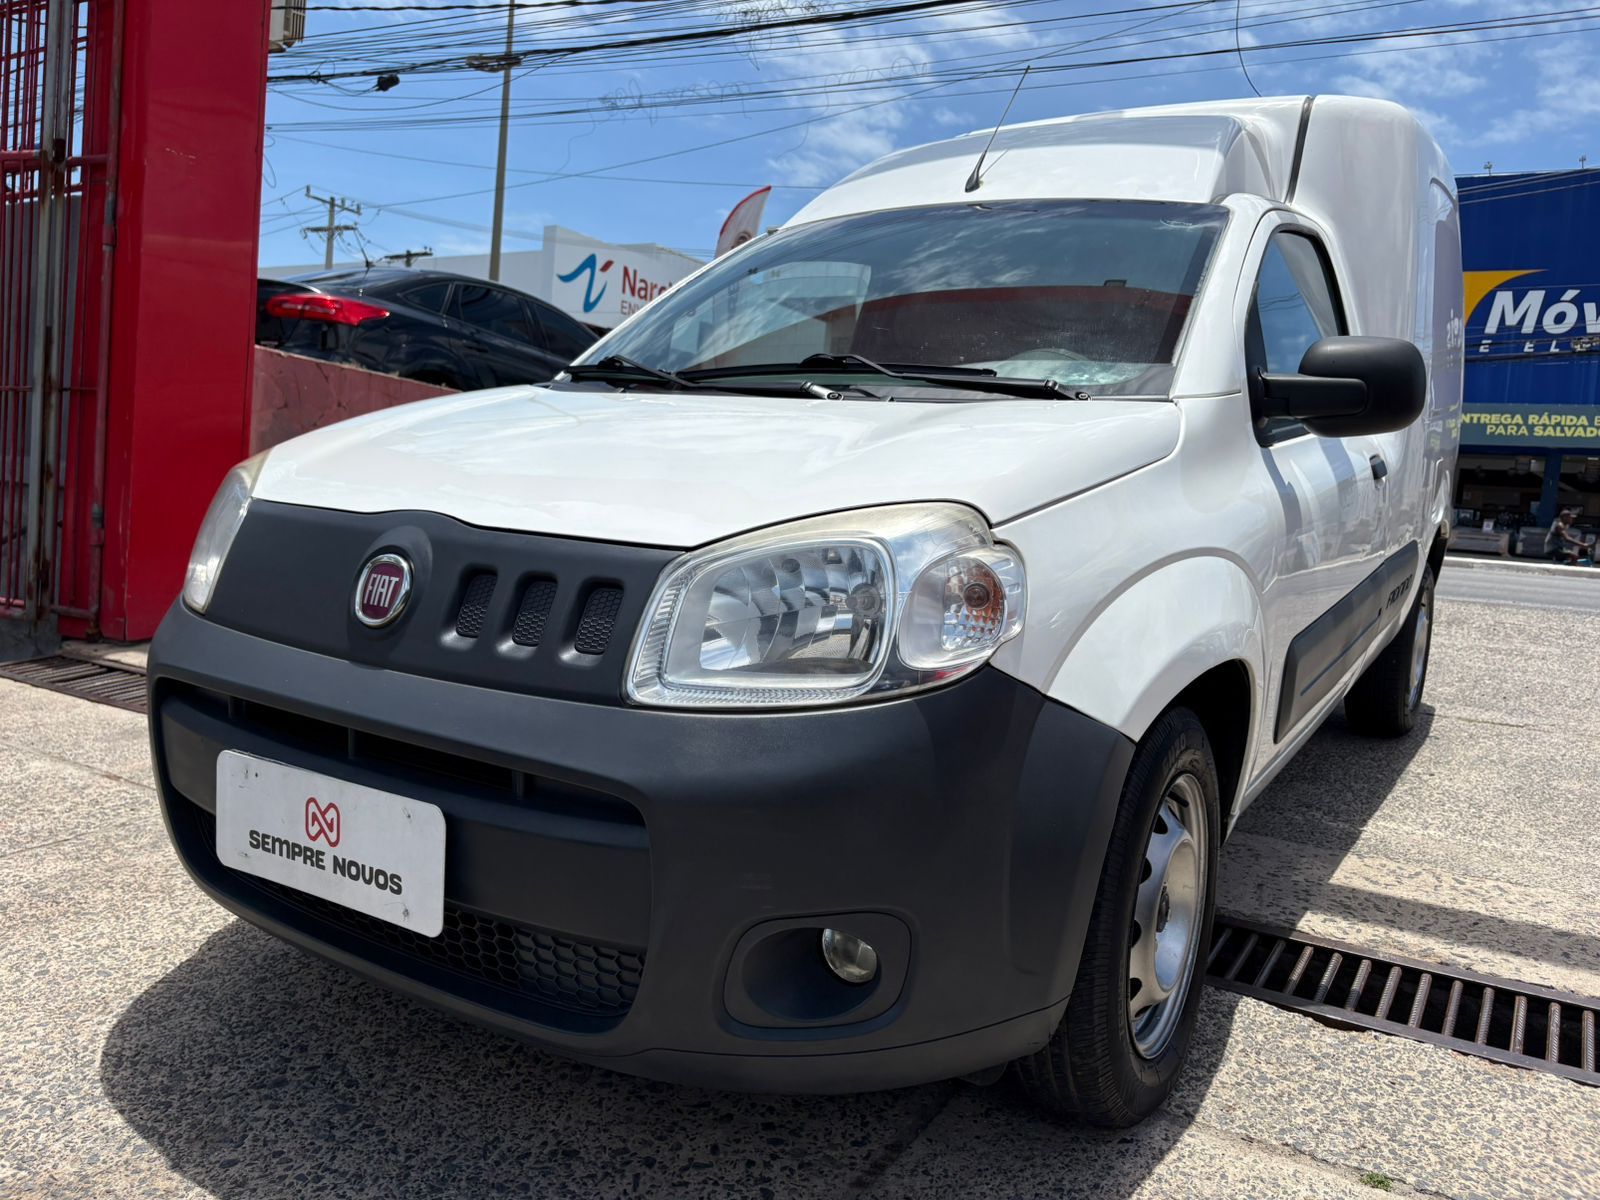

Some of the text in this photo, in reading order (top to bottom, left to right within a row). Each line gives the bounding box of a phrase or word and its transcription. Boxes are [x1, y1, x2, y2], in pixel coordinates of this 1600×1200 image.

[1486, 425, 1528, 436] PARA
[1528, 412, 1588, 426] RÁPIDA
[364, 573, 400, 608] FIAT
[249, 830, 402, 895] SEMPRE NOVOS
